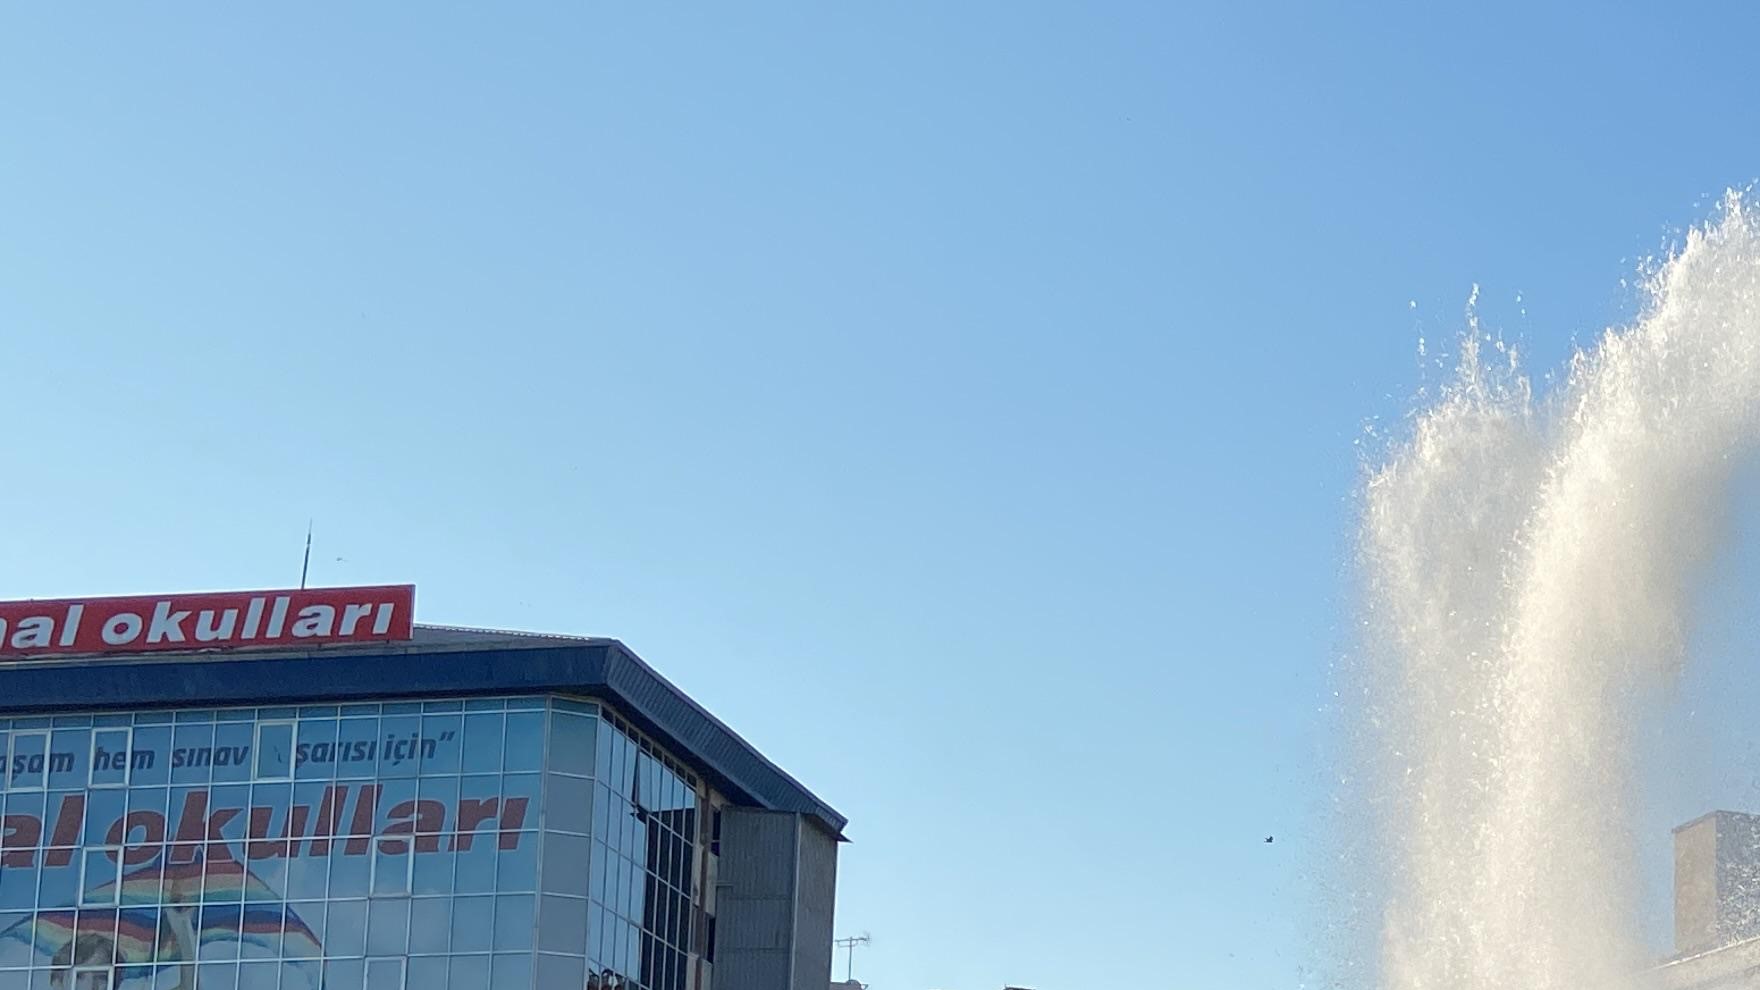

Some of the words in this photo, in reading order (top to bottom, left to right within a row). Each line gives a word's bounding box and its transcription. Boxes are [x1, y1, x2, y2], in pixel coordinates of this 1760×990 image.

[0, 603, 85, 648] al
[101, 596, 395, 645] okulları
[93, 747, 155, 771] hem
[172, 746, 249, 768] sınav
[105, 783, 530, 867] okulları
